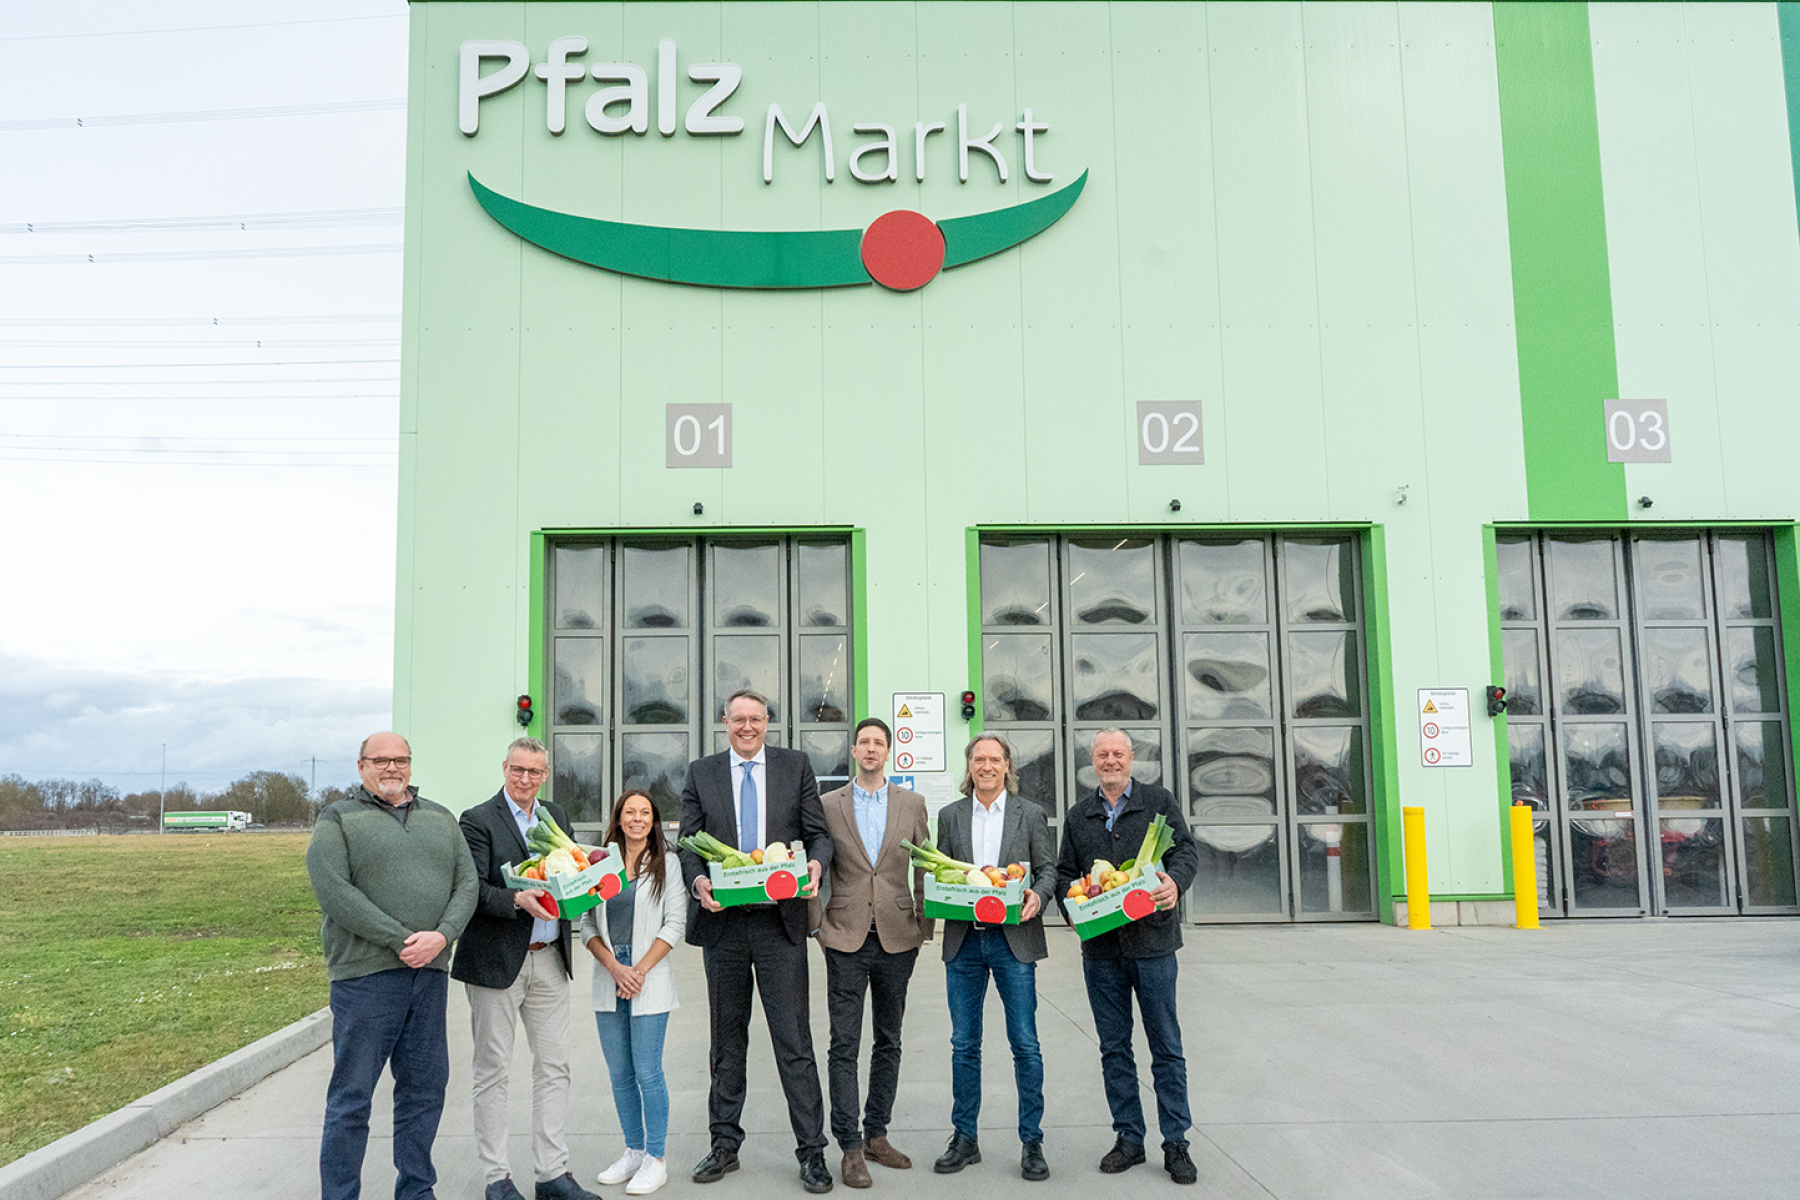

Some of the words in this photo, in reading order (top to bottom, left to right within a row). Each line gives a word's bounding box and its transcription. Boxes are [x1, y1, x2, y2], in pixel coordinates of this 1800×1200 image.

[458, 36, 744, 137] Pfalz
[762, 101, 1054, 186] Markt
[674, 414, 724, 456] 01
[1142, 412, 1200, 453] 02
[1609, 410, 1666, 451] 03
[901, 730, 909, 740] 10
[1427, 726, 1436, 735] 10
[723, 867, 756, 877] Erntefrisch
[936, 885, 967, 893] Erntefrisch
[991, 888, 1006, 896] Pfalz
[1110, 890, 1120, 898] aus
[1121, 885, 1131, 893] der
[1131, 879, 1145, 888] Pfalz
